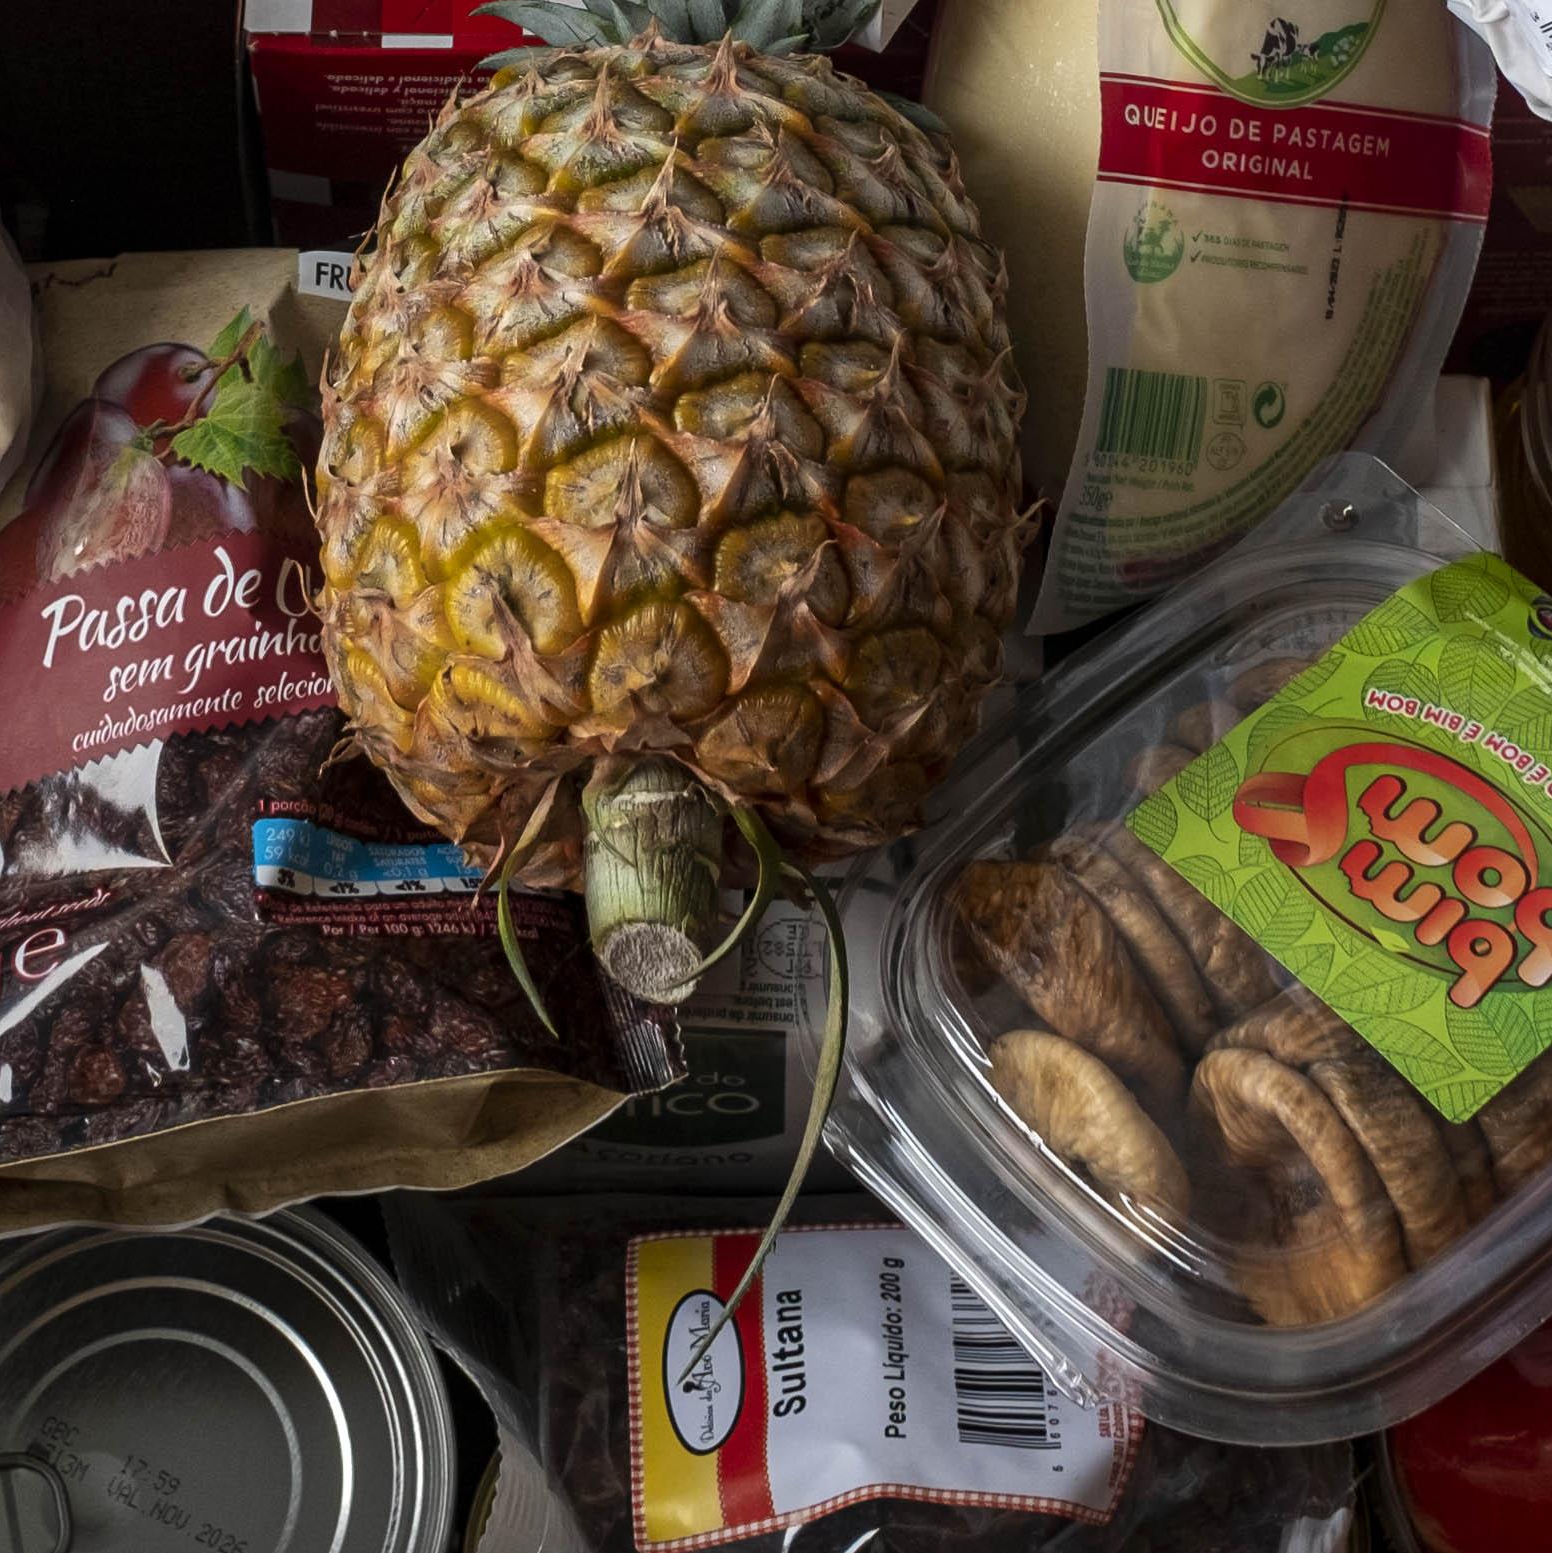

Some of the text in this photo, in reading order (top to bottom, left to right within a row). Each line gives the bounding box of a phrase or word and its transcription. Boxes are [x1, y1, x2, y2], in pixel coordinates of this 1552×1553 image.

[1123, 103, 1391, 159] QUEIJO DE PASTAGEM
[1201, 147, 1314, 181] ORIGINAL
[41, 587, 187, 668] Passa
[203, 546, 262, 618] de
[102, 653, 175, 703] sem
[1366, 688, 1419, 718] BOM
[1422, 704, 1465, 733] BIM
[72, 688, 244, 753] cuidadosamente
[1460, 720, 1484, 742] É
[1482, 732, 1534, 772] BOM
[1525, 763, 1550, 784] É
[266, 827, 296, 842] 249
[263, 846, 283, 860] 59
[1339, 838, 1518, 1010] bim
[695, 1071, 746, 1088] do
[628, 1091, 760, 1118] ICO
[772, 1289, 807, 1417] Sultana
[878, 1256, 910, 1439] Peso Líquido: 200 g
